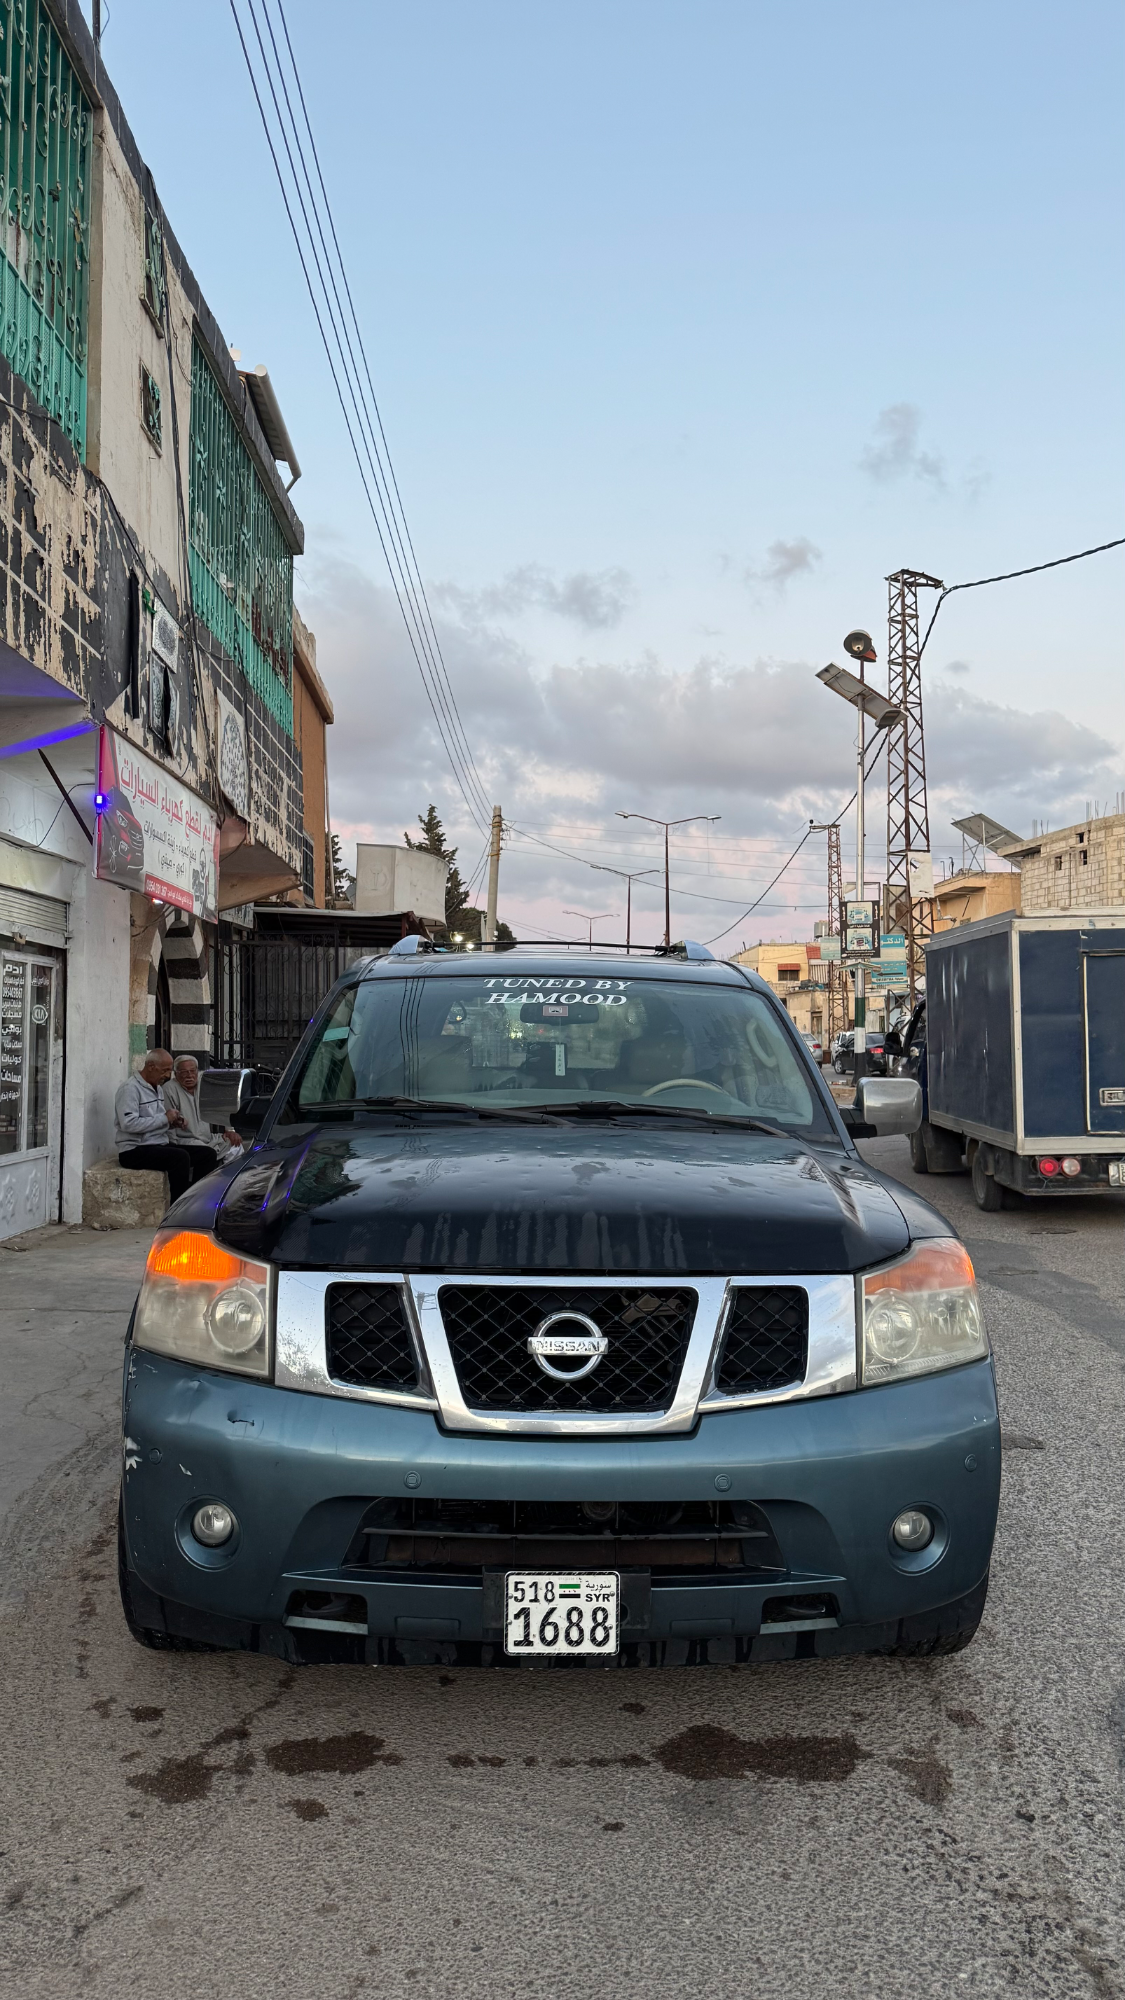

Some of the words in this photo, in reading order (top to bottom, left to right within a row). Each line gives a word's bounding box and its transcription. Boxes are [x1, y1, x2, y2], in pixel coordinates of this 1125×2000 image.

[121, 758, 159, 806] السيارات
[161, 787, 183, 824] كهرباء
[185, 806, 202, 838] لقطع
[483, 978, 587, 989] TUNED
[592, 979, 635, 991] BY
[485, 992, 627, 1006] HAMOOD
[536, 1340, 600, 1352] NISSAN
[513, 1581, 556, 1603] 518
[585, 1580, 612, 1593] سورية
[585, 1593, 611, 1603] SYR
[513, 1606, 611, 1648] 1688
